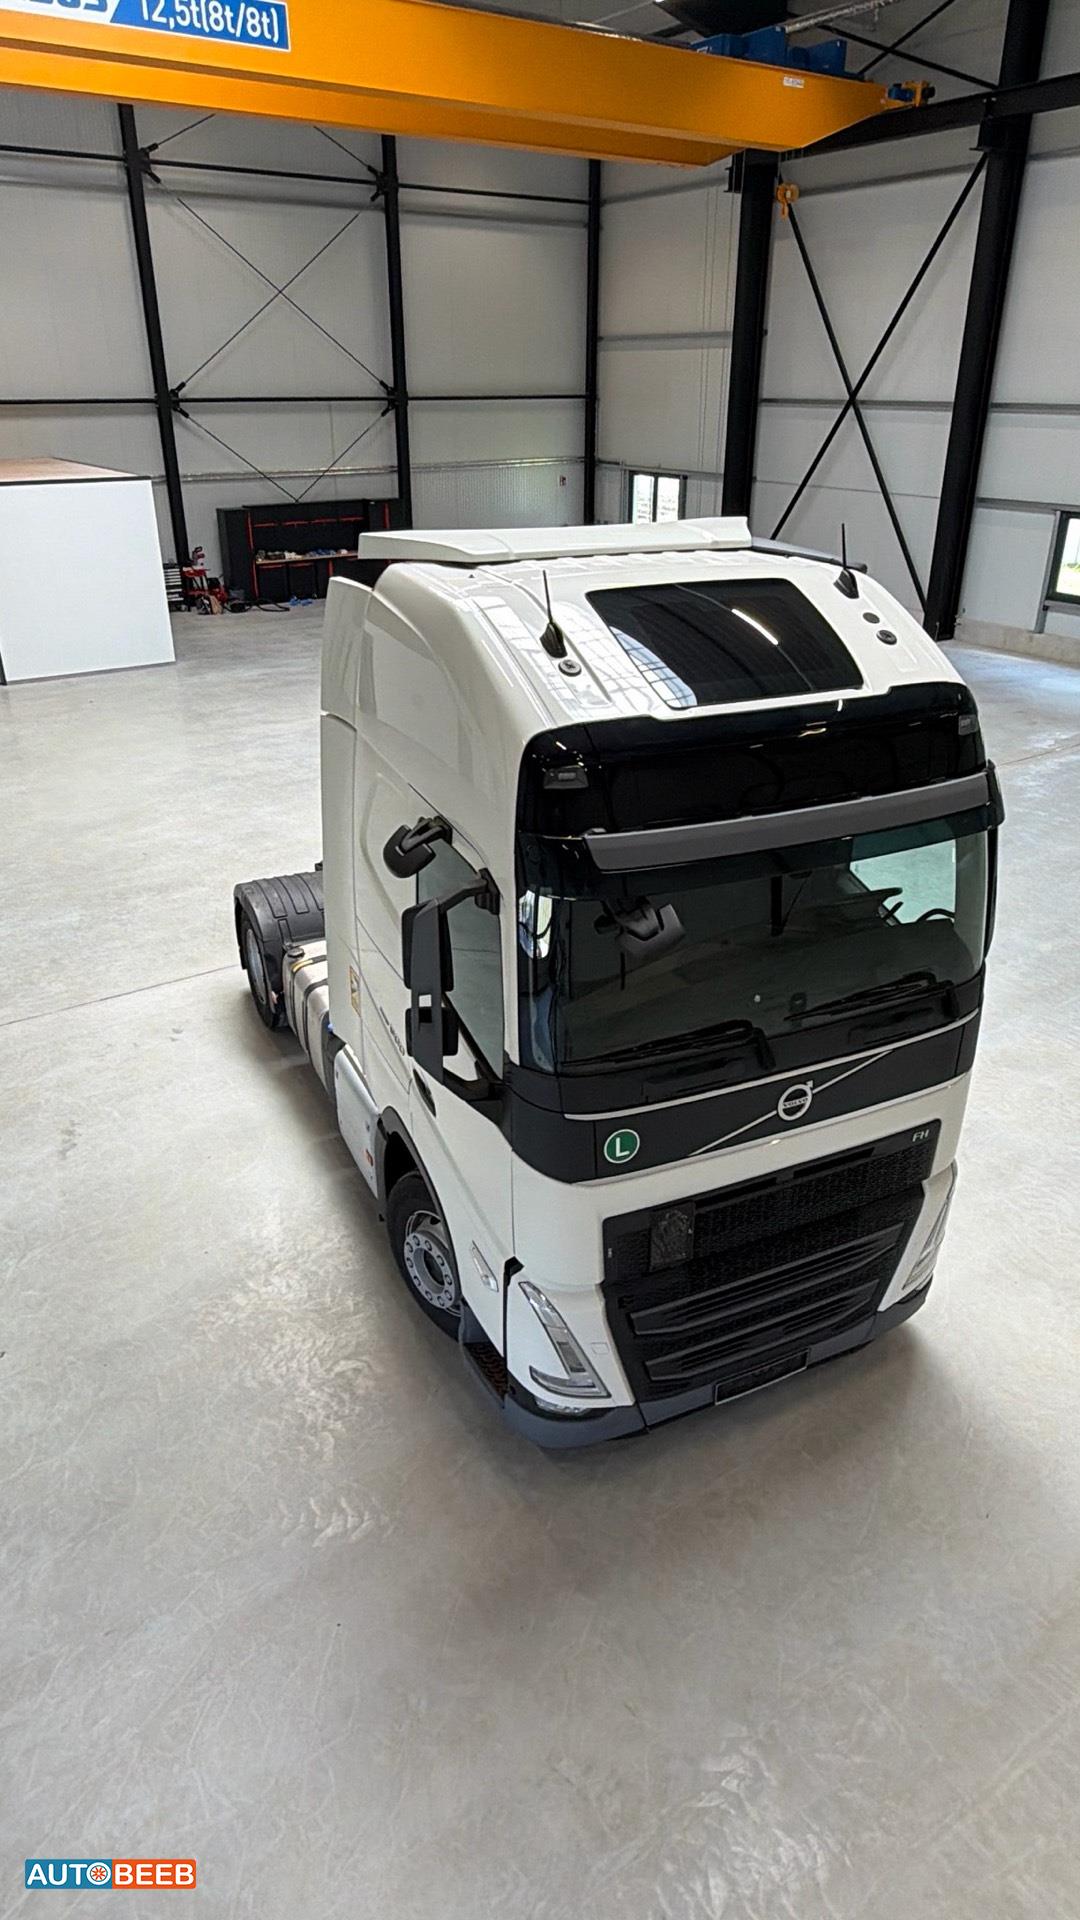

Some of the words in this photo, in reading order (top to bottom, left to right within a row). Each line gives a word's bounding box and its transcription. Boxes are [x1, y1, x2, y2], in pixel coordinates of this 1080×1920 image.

[139, 0, 279, 43] 12,5t(8t/8t)
[912, 1129, 930, 1142] FH
[615, 1137, 630, 1158] L
